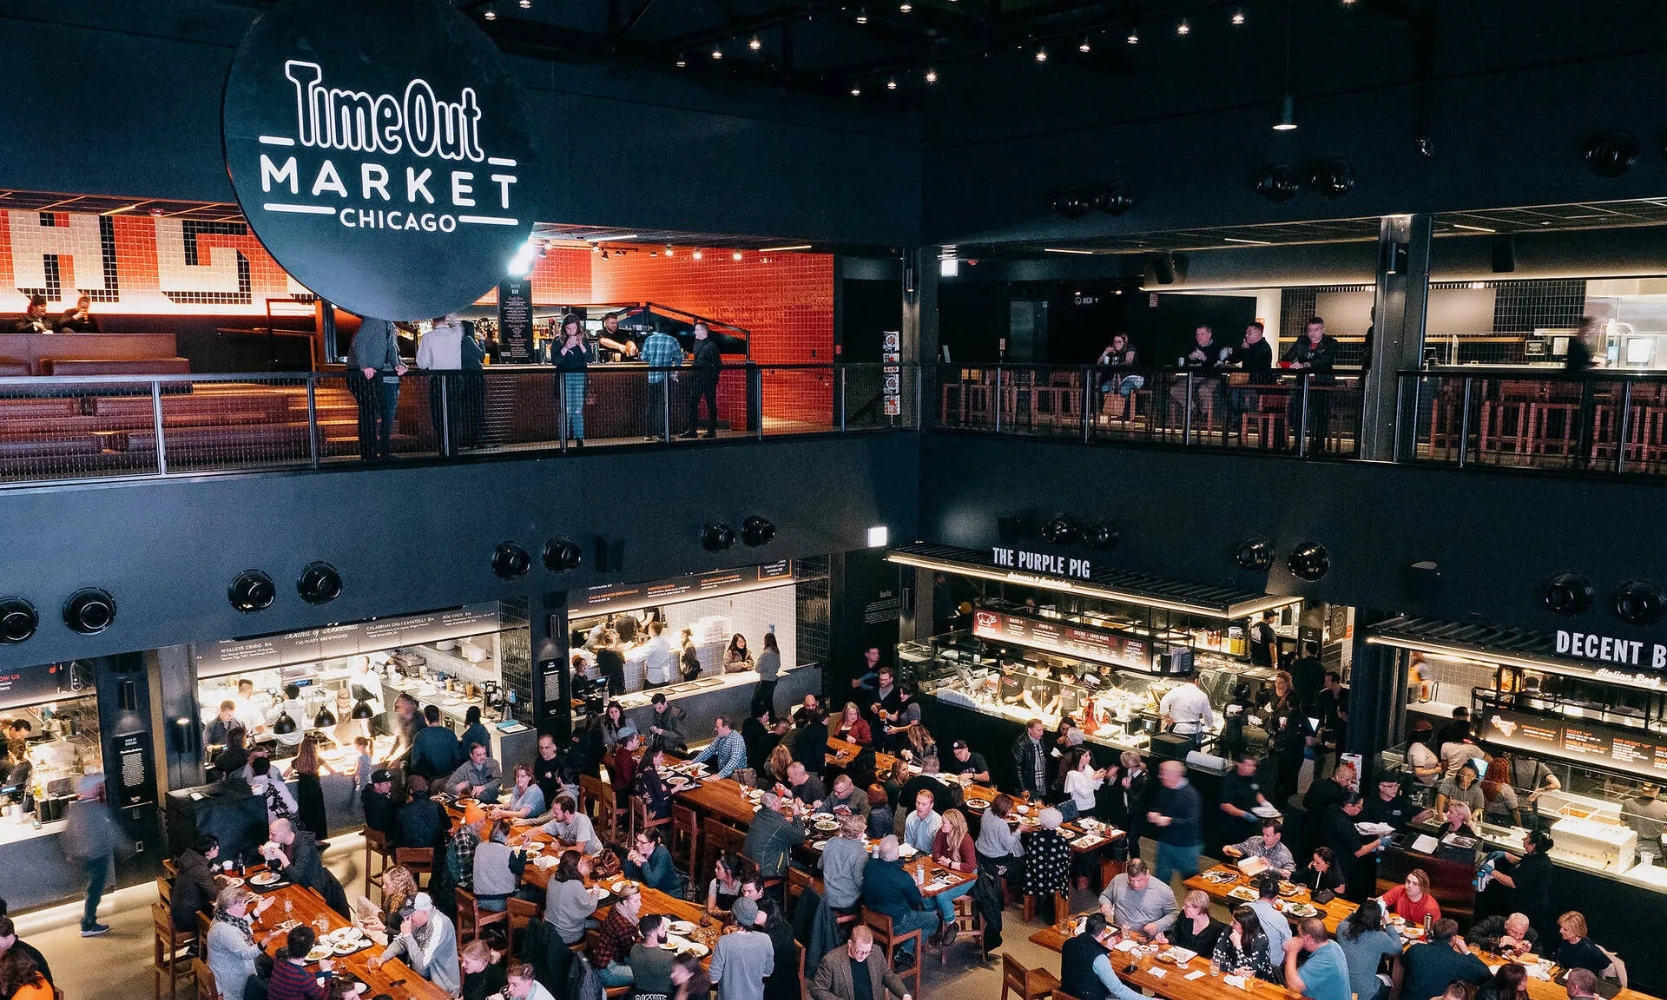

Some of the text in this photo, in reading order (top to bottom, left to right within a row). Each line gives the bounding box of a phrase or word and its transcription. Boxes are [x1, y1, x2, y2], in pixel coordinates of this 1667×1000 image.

[285, 59, 485, 162] Time Out
[259, 153, 518, 209] MARKET
[339, 207, 457, 233] CHICAGO
[992, 546, 1091, 578] THE PURPLE PIG
[1556, 630, 1667, 668] DECENT B
[1595, 668, 1661, 689] Italian Beef
